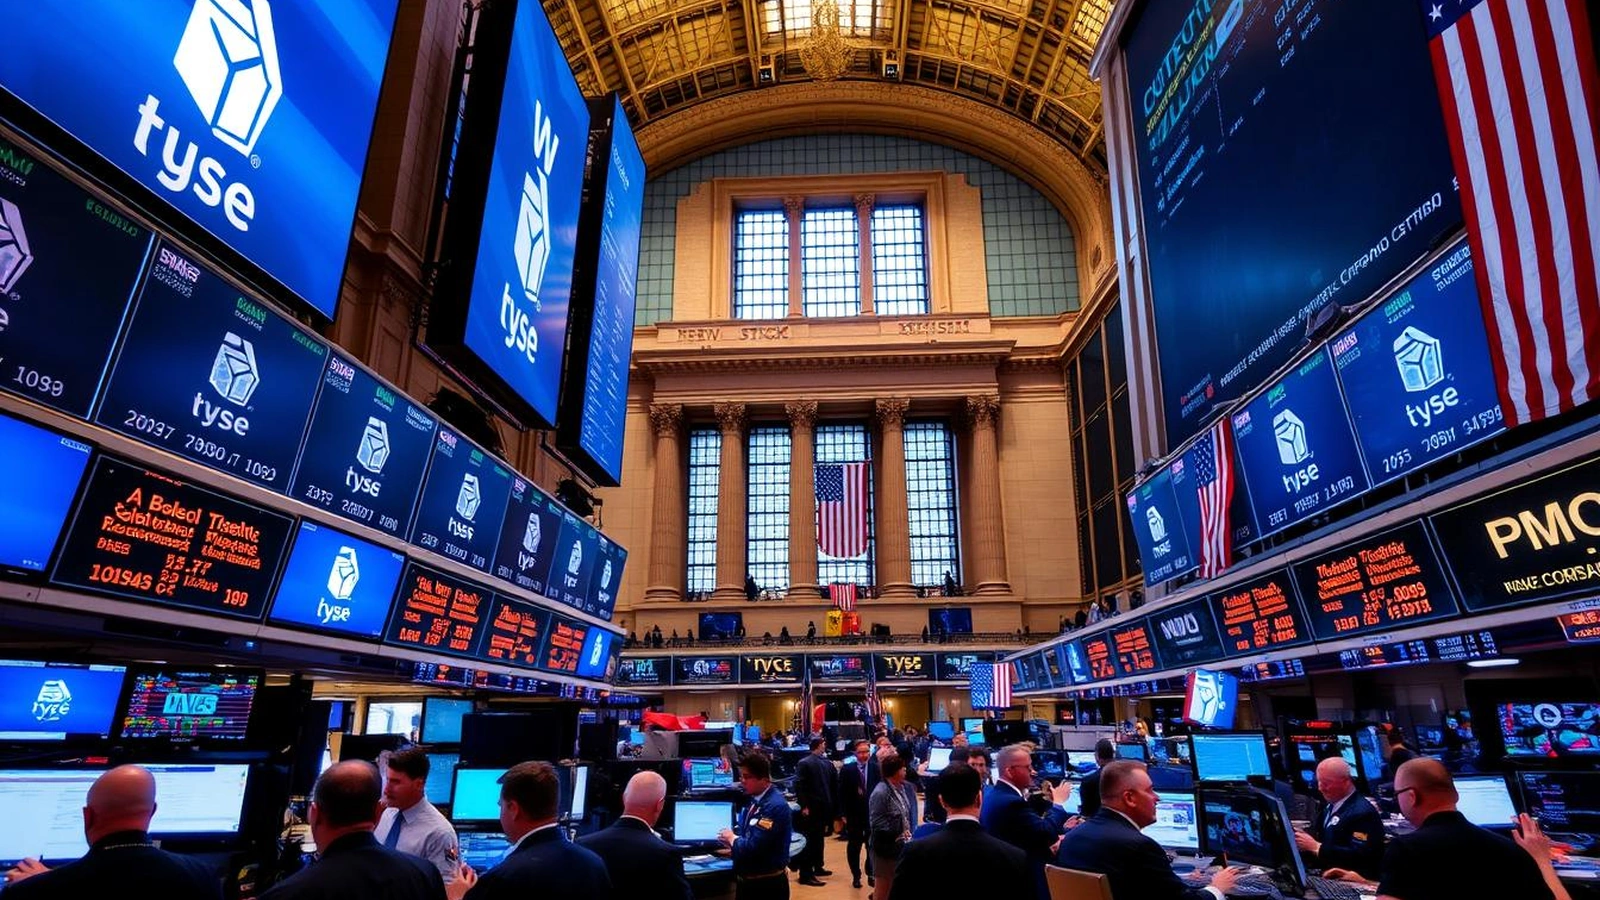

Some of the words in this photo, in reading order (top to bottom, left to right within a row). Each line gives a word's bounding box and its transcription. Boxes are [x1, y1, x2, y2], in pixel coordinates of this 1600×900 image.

[133, 94, 255, 232] tyse
[533, 98, 560, 176] W
[500, 282, 539, 364] tyse
[192, 392, 250, 436] tyse
[1405, 386, 1459, 427] tyse
[126, 487, 142, 507] A
